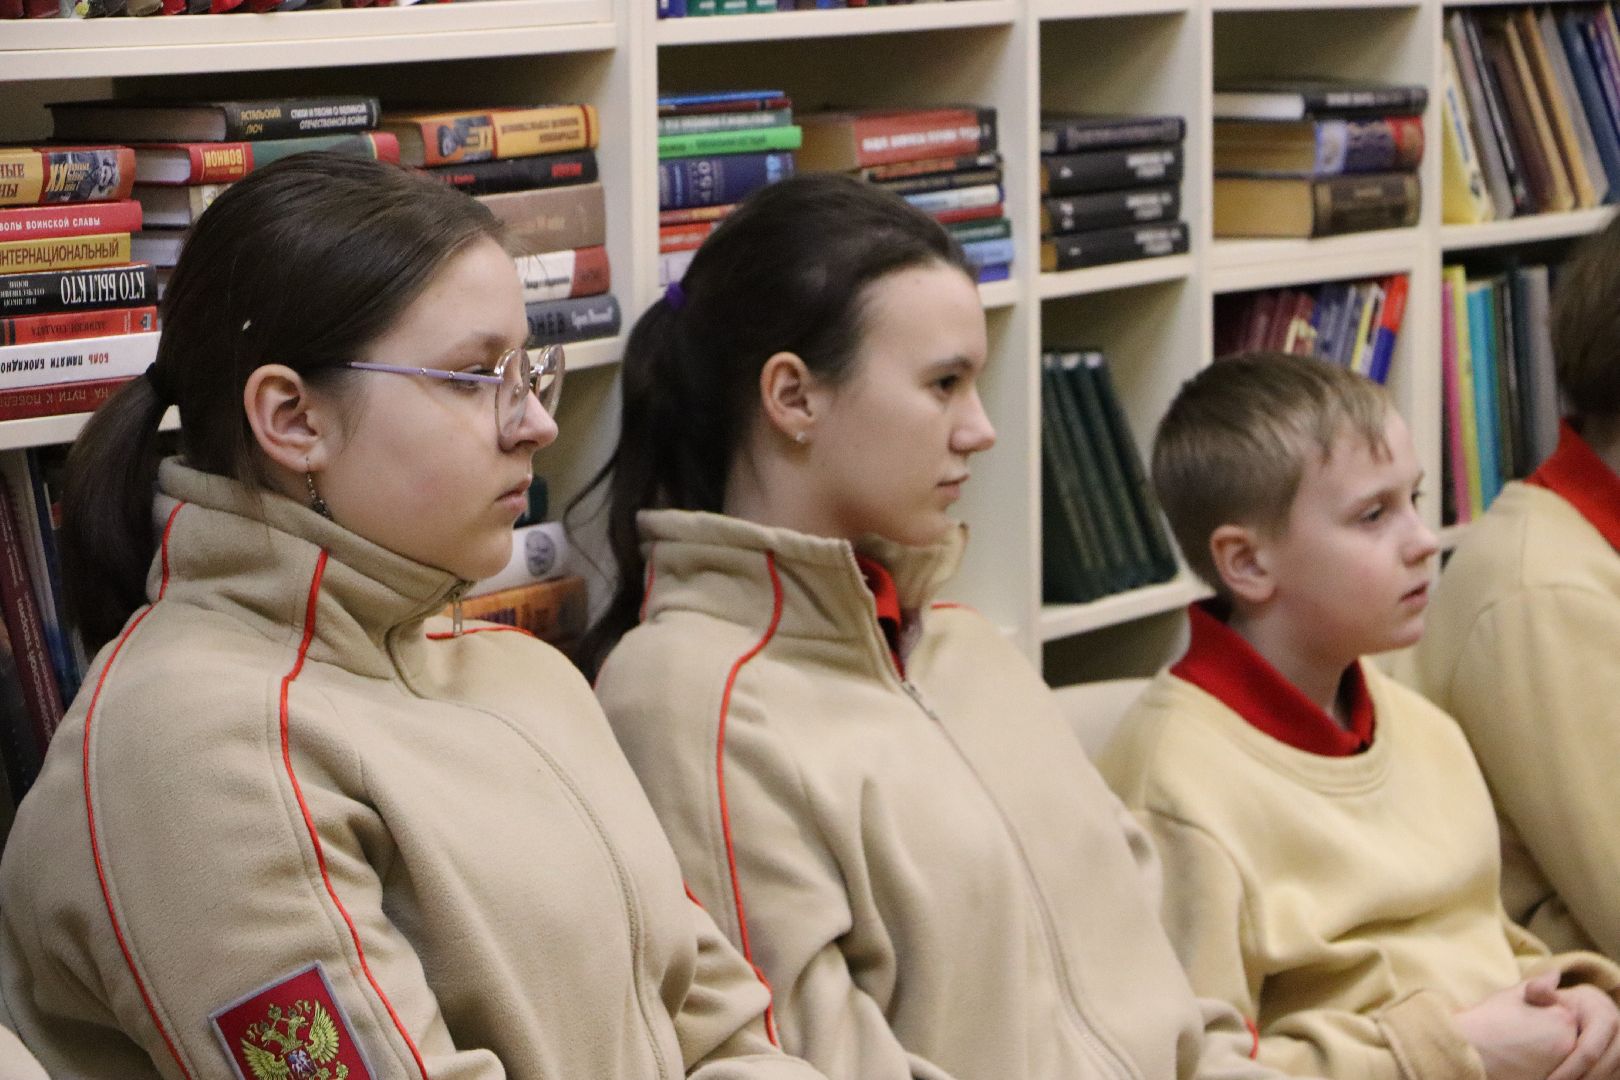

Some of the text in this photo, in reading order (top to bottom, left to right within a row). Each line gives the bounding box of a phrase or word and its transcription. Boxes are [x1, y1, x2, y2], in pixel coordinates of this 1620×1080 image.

[26, 216, 70, 230] ВОИНСКОЙ
[72, 217, 100, 228] СЛАВЫ
[60, 271, 145, 304] КТО БЫЛ КТО
[50, 354, 83, 367] ПАМЯТИ
[89, 352, 109, 363] БОЛЬ
[46, 393, 53, 404] К
[59, 390, 85, 402] ПУТИ
[94, 387, 109, 399] НА
